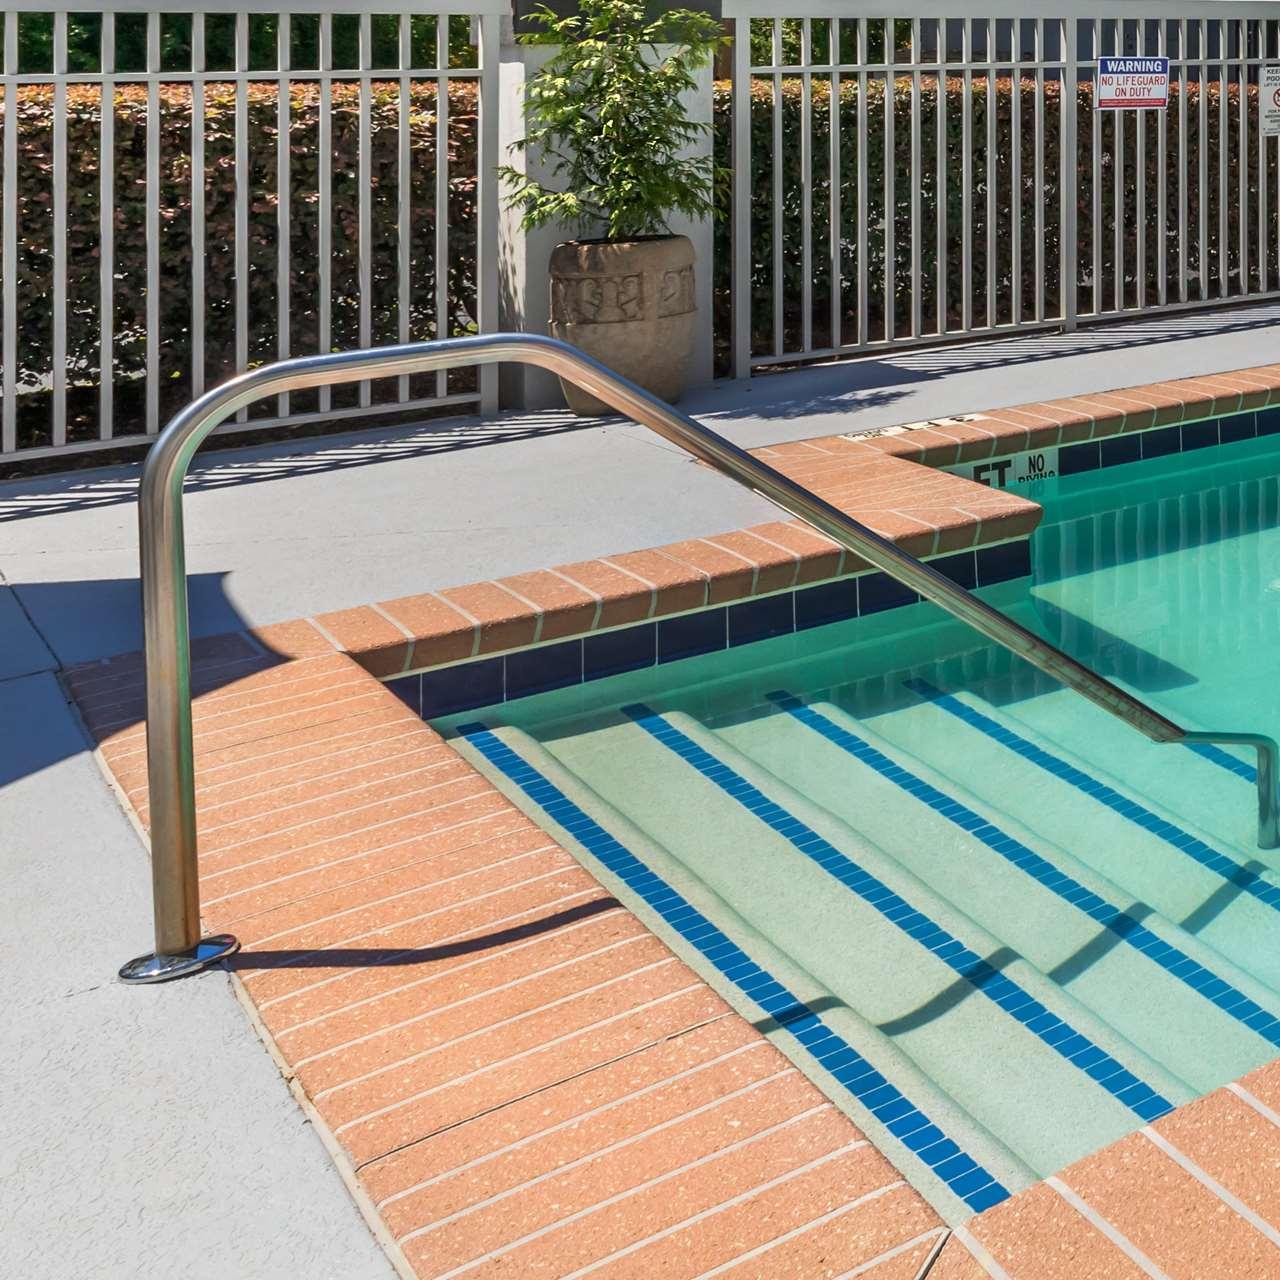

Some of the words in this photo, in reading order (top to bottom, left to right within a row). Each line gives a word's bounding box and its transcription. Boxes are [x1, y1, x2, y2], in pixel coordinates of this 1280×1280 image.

[1107, 60, 1162, 72] WARNING
[1101, 76, 1114, 86] NO
[1116, 76, 1166, 86] LIFEGUARD
[1115, 87, 1127, 97] ON
[1129, 87, 1152, 97] DUTY
[1028, 454, 1045, 474] NO
[973, 460, 1012, 488] FT
